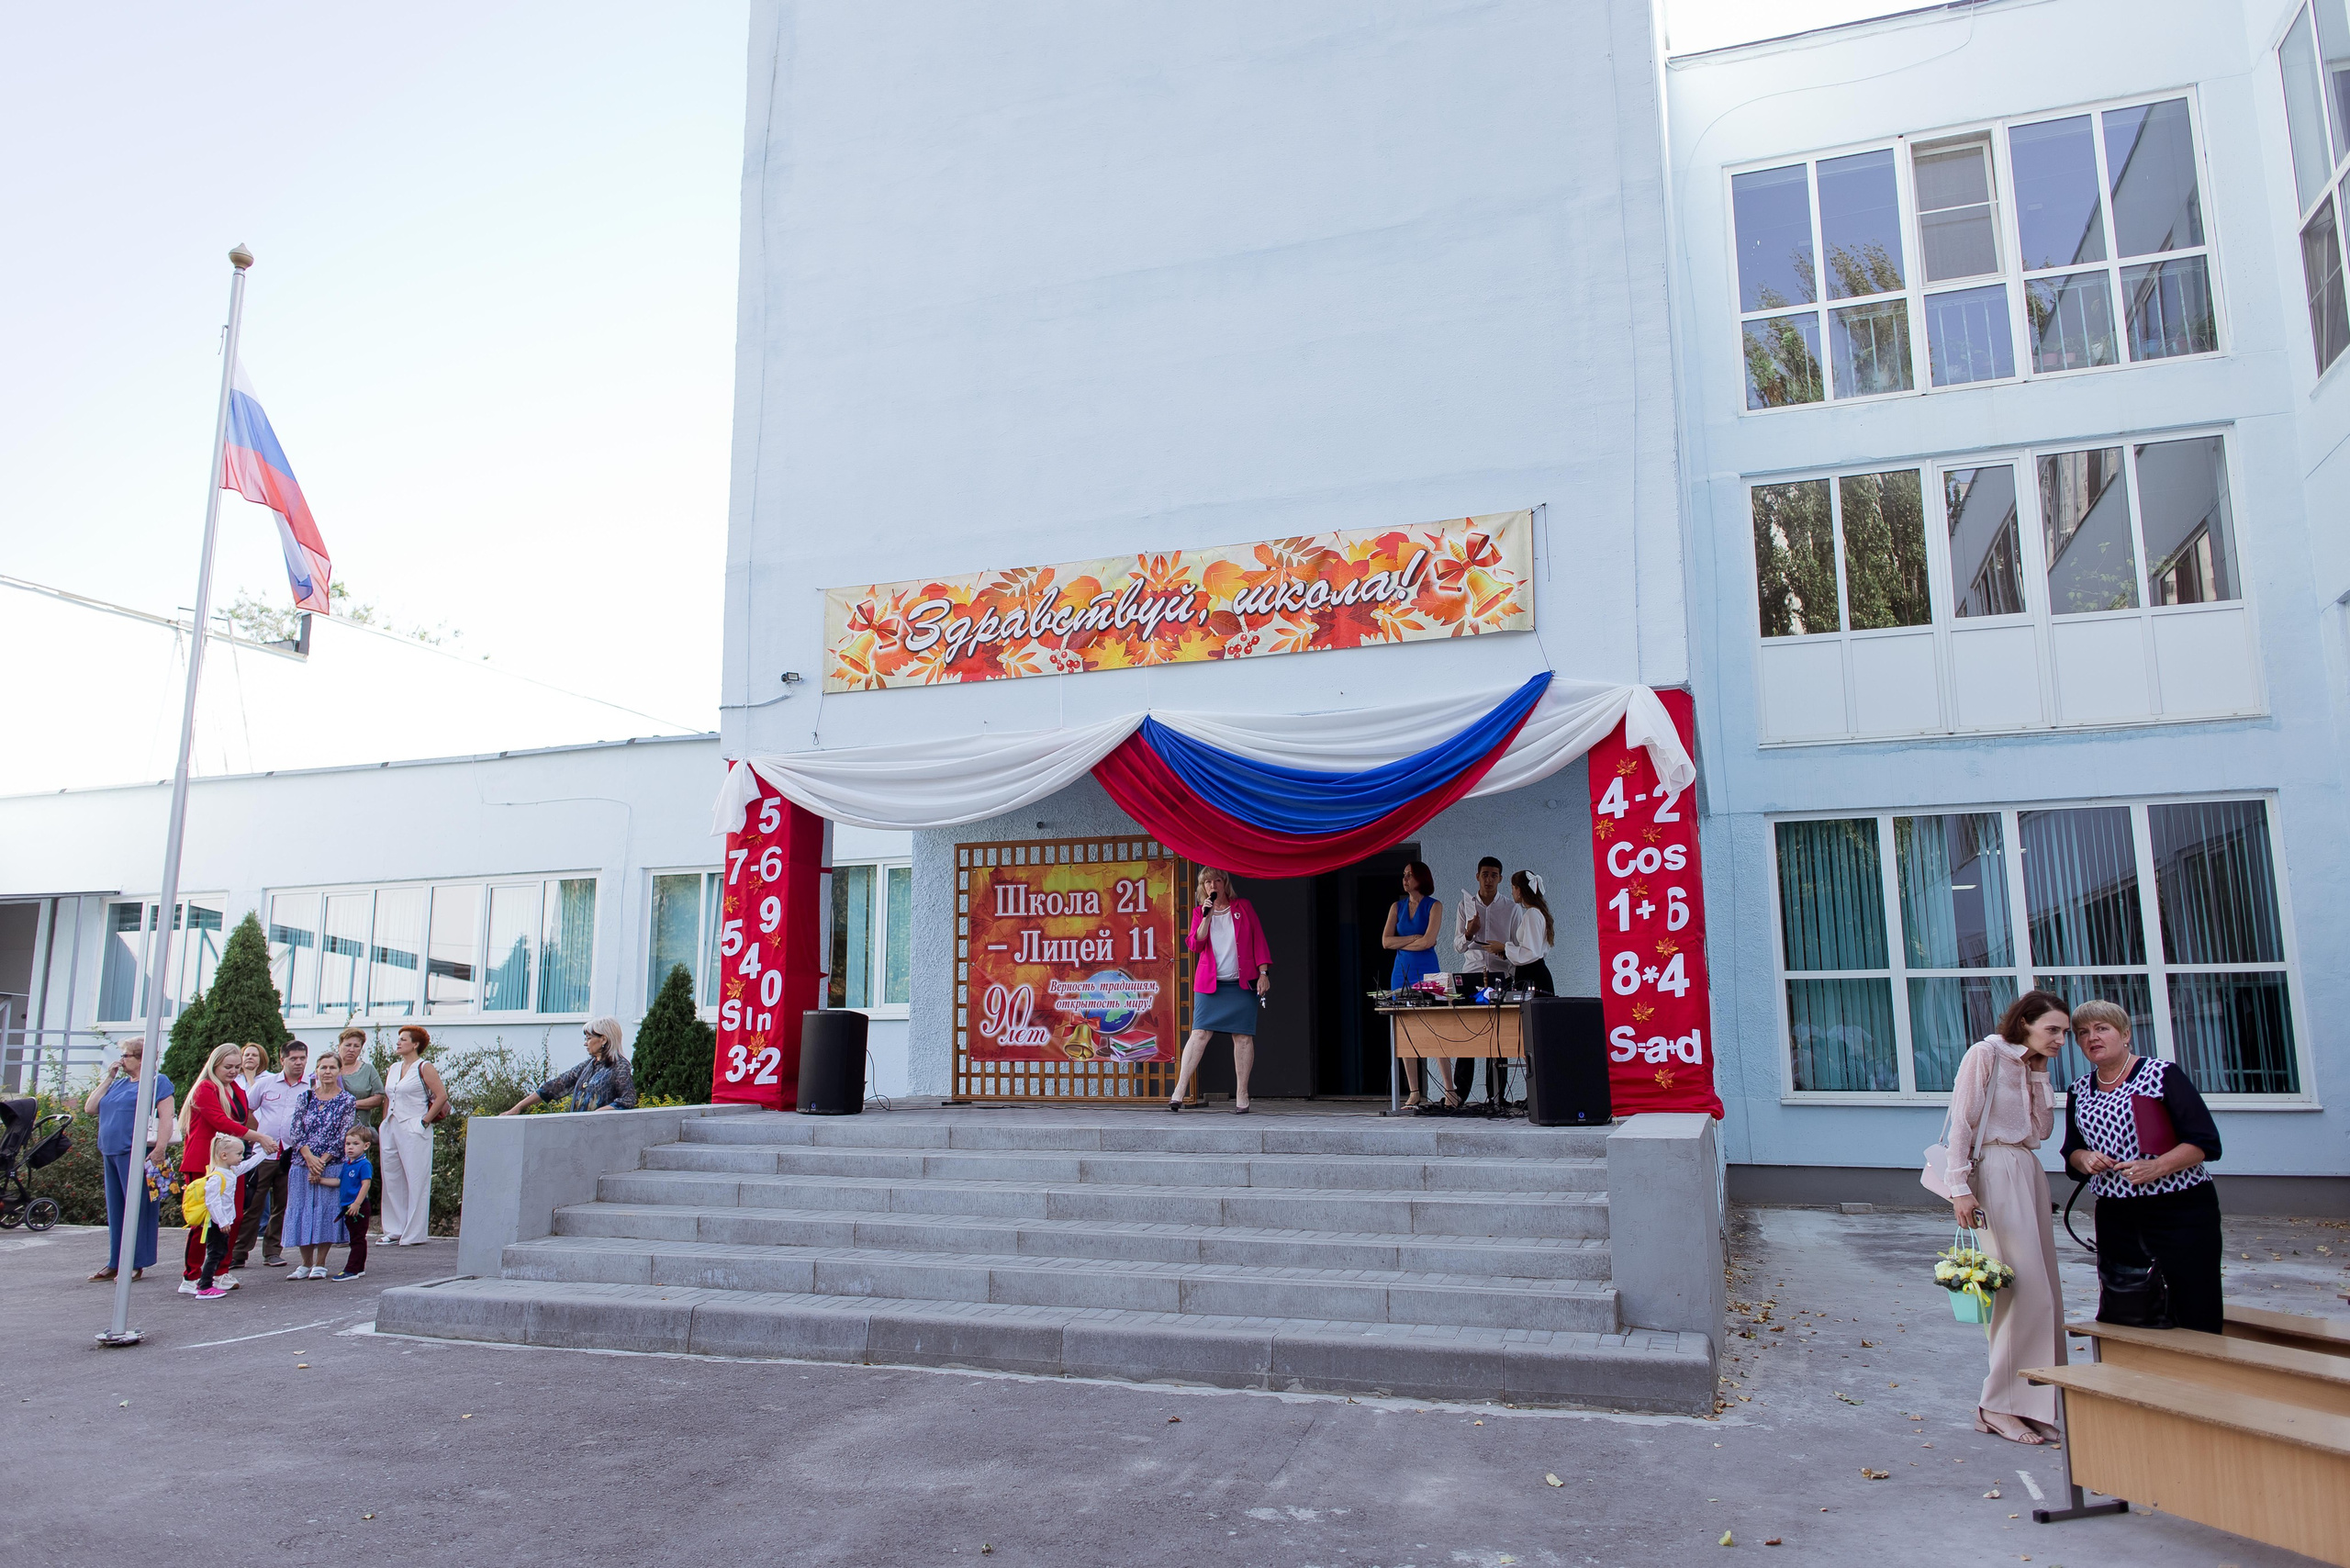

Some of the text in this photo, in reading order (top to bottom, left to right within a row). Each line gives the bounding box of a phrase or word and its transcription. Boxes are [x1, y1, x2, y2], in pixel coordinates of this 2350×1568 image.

[907, 550, 1427, 664] Здравствуй, школа!
[758, 796, 781, 834] 5
[1607, 841, 1687, 878] Cos
[759, 895, 782, 934] 9
[994, 879, 1148, 917] Школа 21
[721, 918, 744, 958] 5
[1014, 929, 1113, 968] Лицей
[1129, 926, 1158, 961] 11
[738, 942, 762, 980] 4
[760, 969, 783, 1008] 0
[1050, 980, 1159, 994] Верность традициям,
[1056, 996, 1153, 1012] открытость миру!
[981, 986, 1032, 1035] 90
[999, 1028, 1050, 1044] лет
[725, 1044, 781, 1085] 3+2
